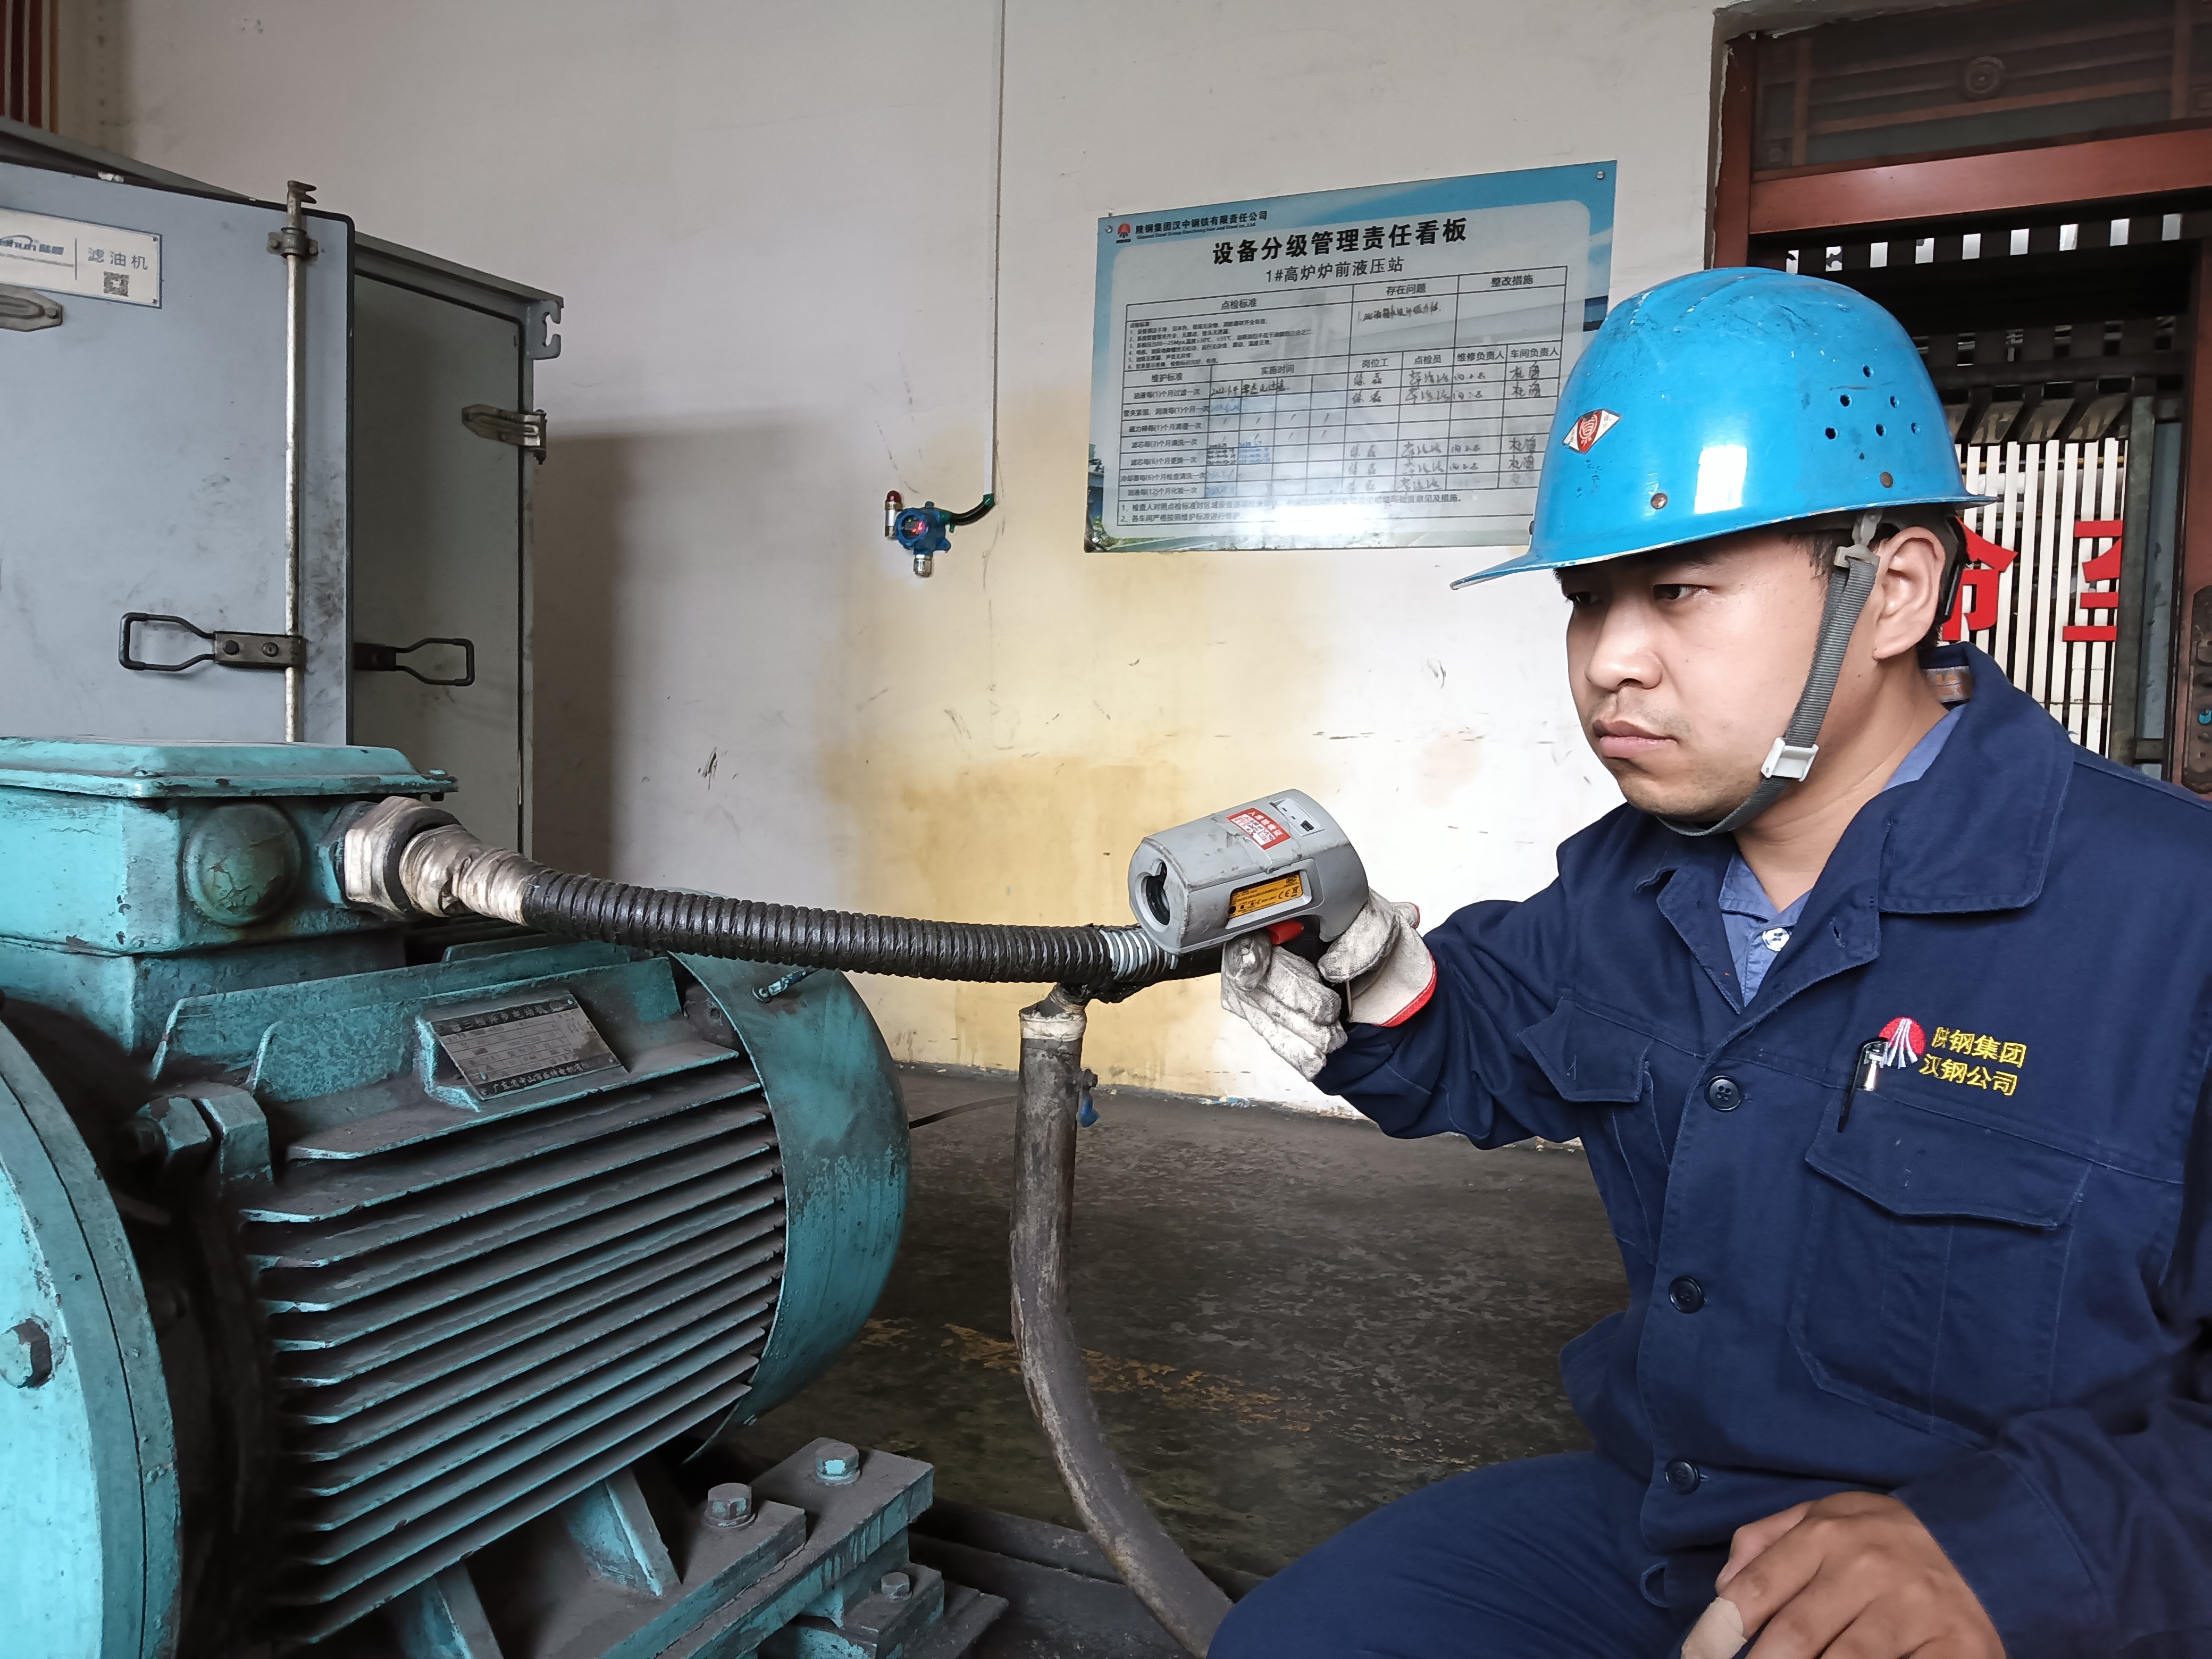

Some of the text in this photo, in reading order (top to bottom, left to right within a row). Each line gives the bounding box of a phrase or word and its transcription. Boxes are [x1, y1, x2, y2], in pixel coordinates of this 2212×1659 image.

[1135, 211, 1268, 234] 陕钢集团汉中钢铁有限责任公司
[1213, 217, 1467, 265] 设备分级管理责任看板
[87, 247, 148, 270] 滤油机
[1266, 256, 1404, 282] 1#高炉炉前液压站
[1491, 274, 1534, 287] 整改措施
[1386, 283, 1427, 296] 存在问题
[1221, 298, 1257, 310] 点检标准
[1457, 350, 1505, 362] 维修负责人
[1510, 347, 1559, 358] 车间负责人
[1362, 358, 1388, 368] 岗位工
[1413, 355, 1442, 365] 点检员
[1261, 364, 1295, 374] 实施时间
[1151, 373, 1183, 382] 维护标准
[1931, 1027, 2027, 1068] 陕钢集团
[1918, 1053, 2017, 1096] 汉钢公司
